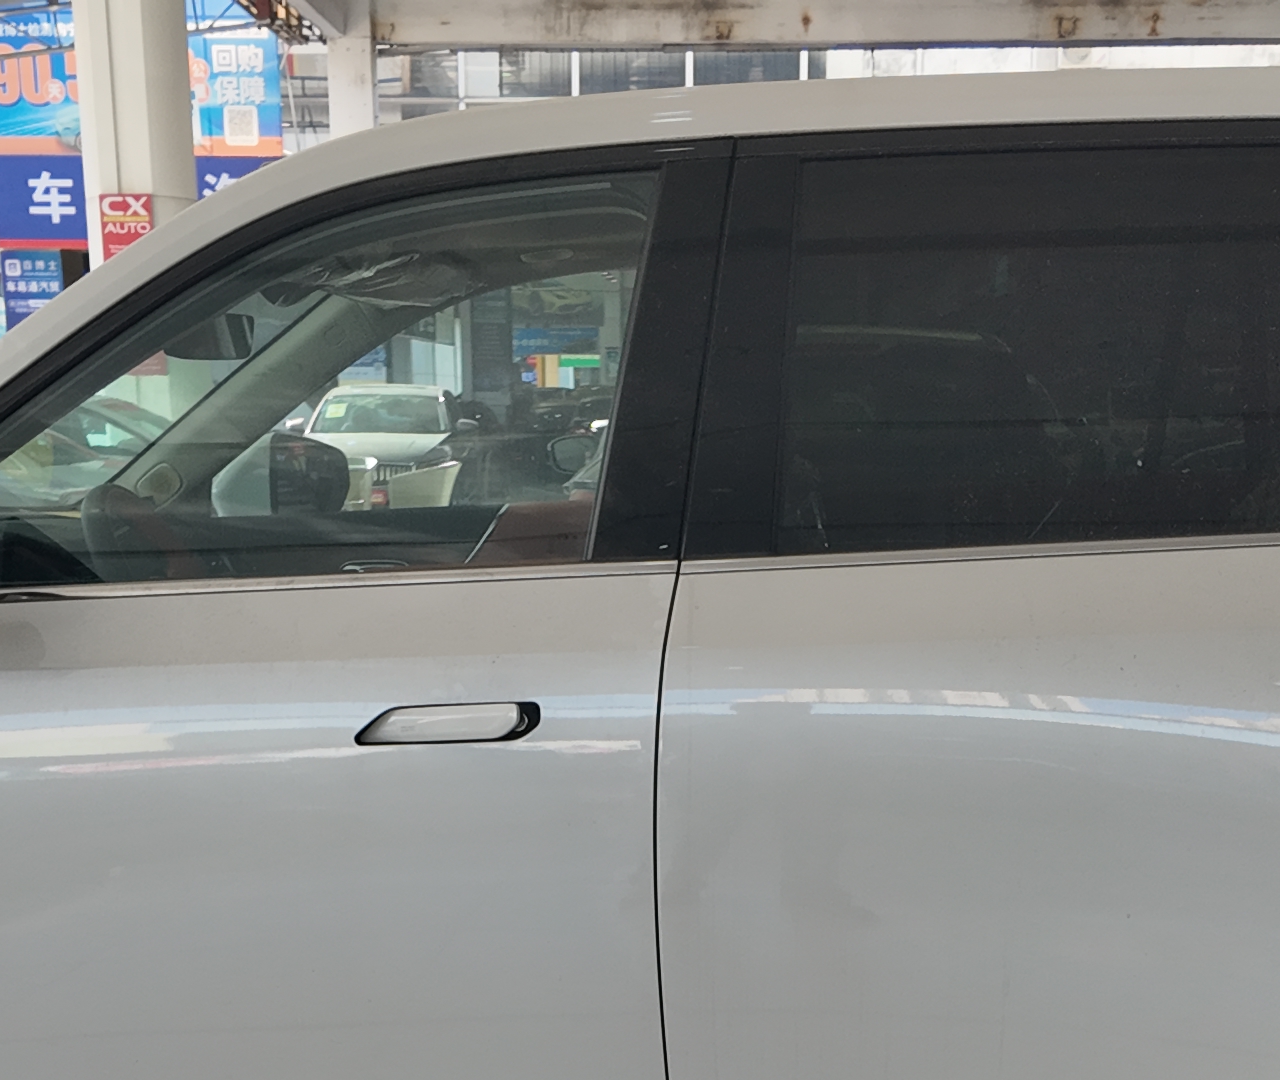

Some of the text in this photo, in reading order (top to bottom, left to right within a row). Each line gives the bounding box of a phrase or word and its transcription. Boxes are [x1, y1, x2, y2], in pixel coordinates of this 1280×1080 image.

[211, 44, 264, 73] 回购
[47, 82, 62, 99] 天
[214, 75, 266, 105] 保障
[28, 171, 76, 224] 车
[101, 196, 149, 216] CX
[104, 222, 151, 235] AUTO
